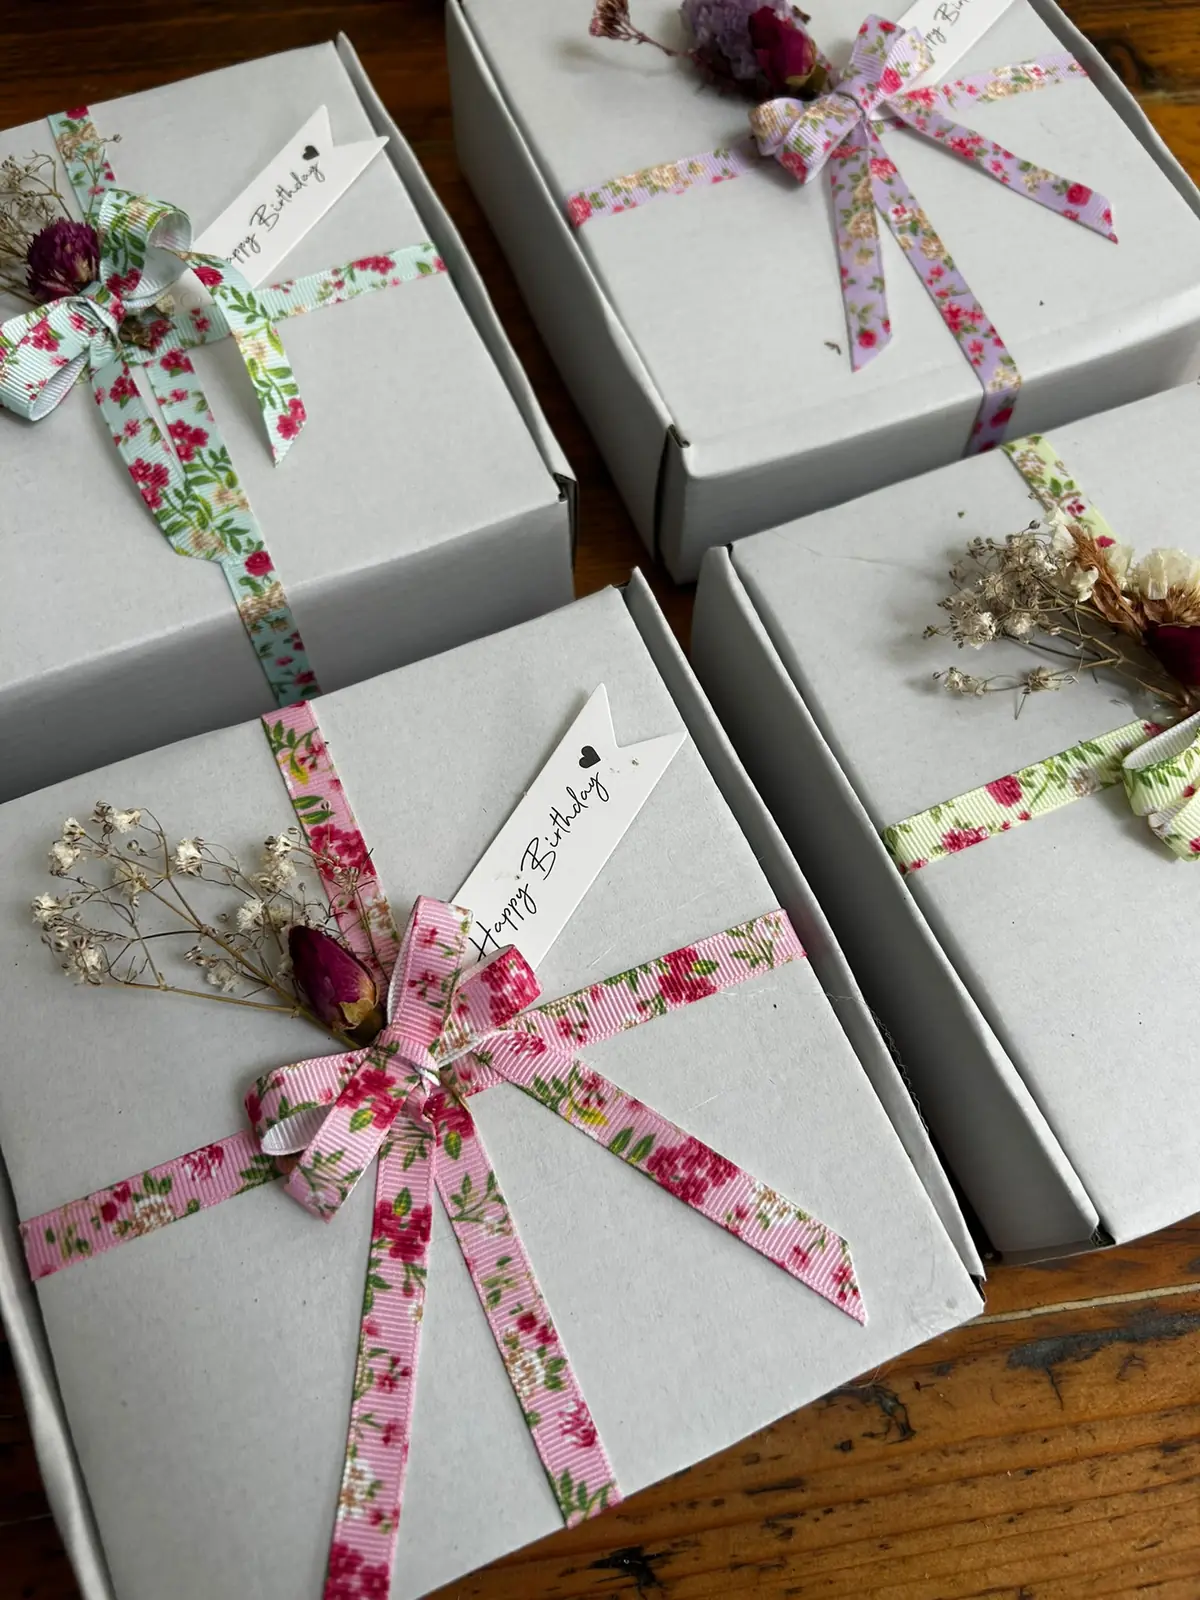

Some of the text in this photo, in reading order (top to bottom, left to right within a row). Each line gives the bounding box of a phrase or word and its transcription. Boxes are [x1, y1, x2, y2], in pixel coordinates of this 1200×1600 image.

[249, 161, 326, 232] Birthday
[468, 772, 610, 962] Happy Birthday
